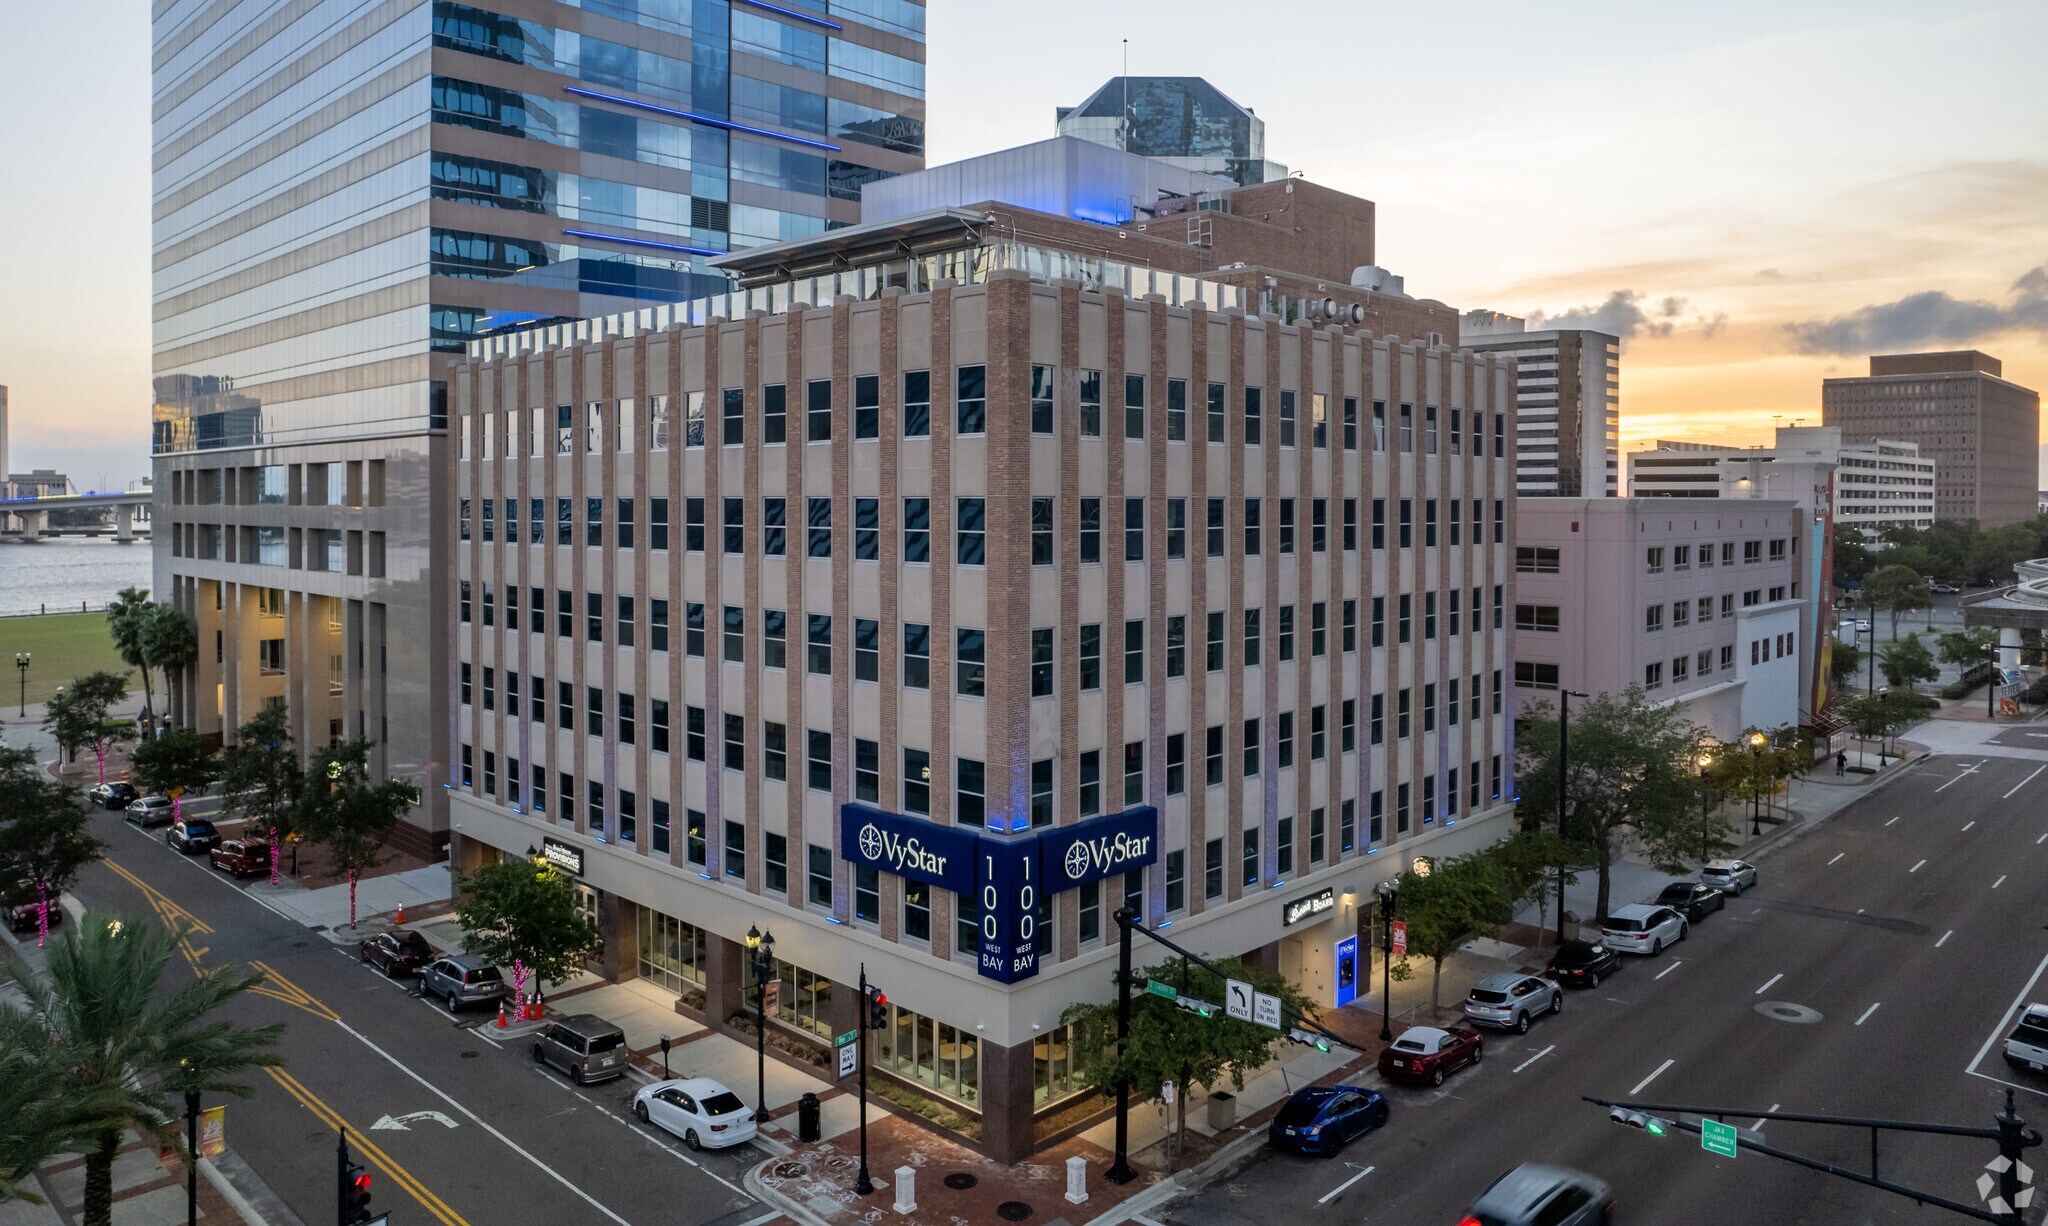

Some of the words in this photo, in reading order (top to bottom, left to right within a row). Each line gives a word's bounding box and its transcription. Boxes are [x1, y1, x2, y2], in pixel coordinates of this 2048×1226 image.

[545, 847, 580, 869] PROVISIONS
[881, 830, 947, 876] VyStar
[1088, 832, 1150, 874] VyStar
[984, 855, 997, 940] 100
[1021, 856, 1033, 940] 100
[984, 942, 1001, 954] WEST
[1015, 942, 1032, 954] WEST
[982, 953, 1004, 971] BAY
[1013, 953, 1034, 972] BAY
[1262, 998, 1272, 1007] NO
[1230, 1005, 1249, 1017] ONLY
[1260, 1006, 1275, 1015] TURN
[1256, 1012, 1265, 1020] ON
[1266, 1015, 1278, 1025] RED
[841, 1046, 854, 1057] ONE
[842, 1053, 855, 1064] WAY
[1714, 1126, 1725, 1135] JAX
[1704, 1131, 1734, 1145] CHAMBER
